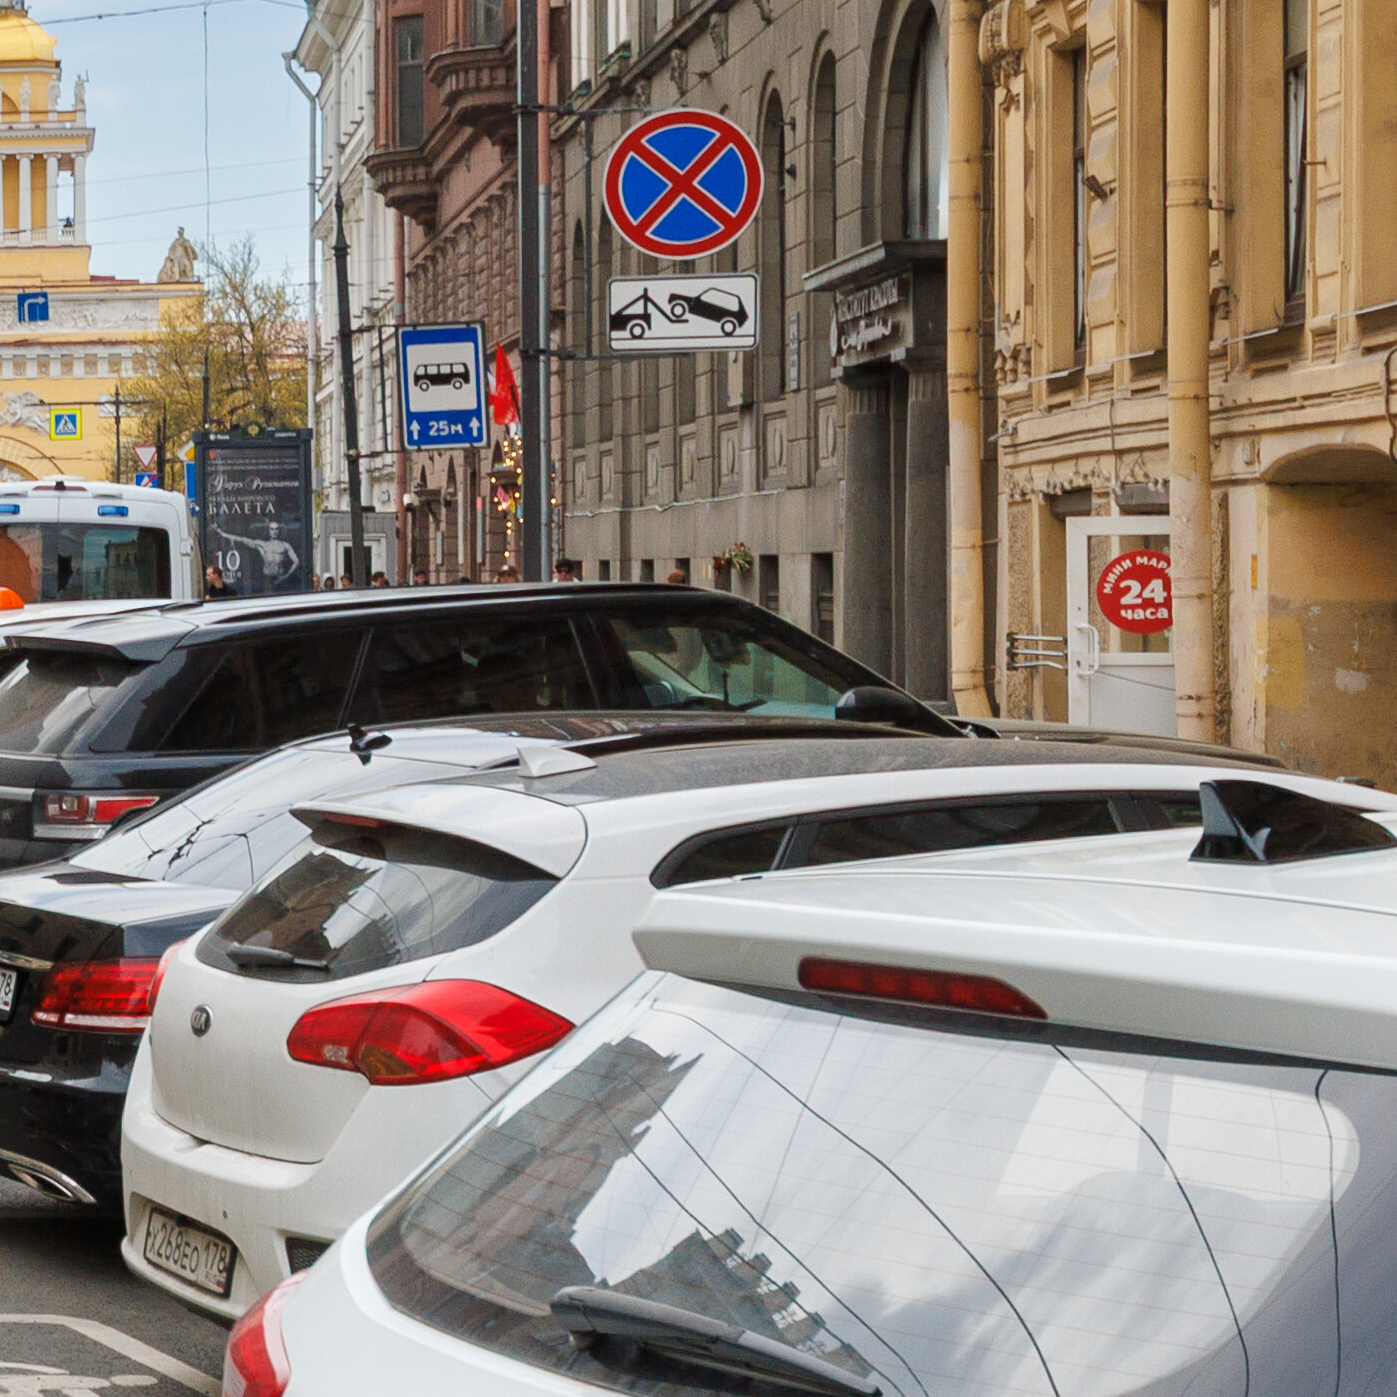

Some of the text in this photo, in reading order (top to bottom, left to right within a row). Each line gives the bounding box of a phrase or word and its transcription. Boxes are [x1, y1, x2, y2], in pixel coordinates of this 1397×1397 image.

[209, 502, 275, 515] БАЛЕТА
[216, 550, 240, 571] 10
[1103, 559, 1132, 594] МИНИ
[1120, 578, 1167, 605] 24
[1120, 607, 1168, 620] часа
[204, 1240, 228, 1274] 178
